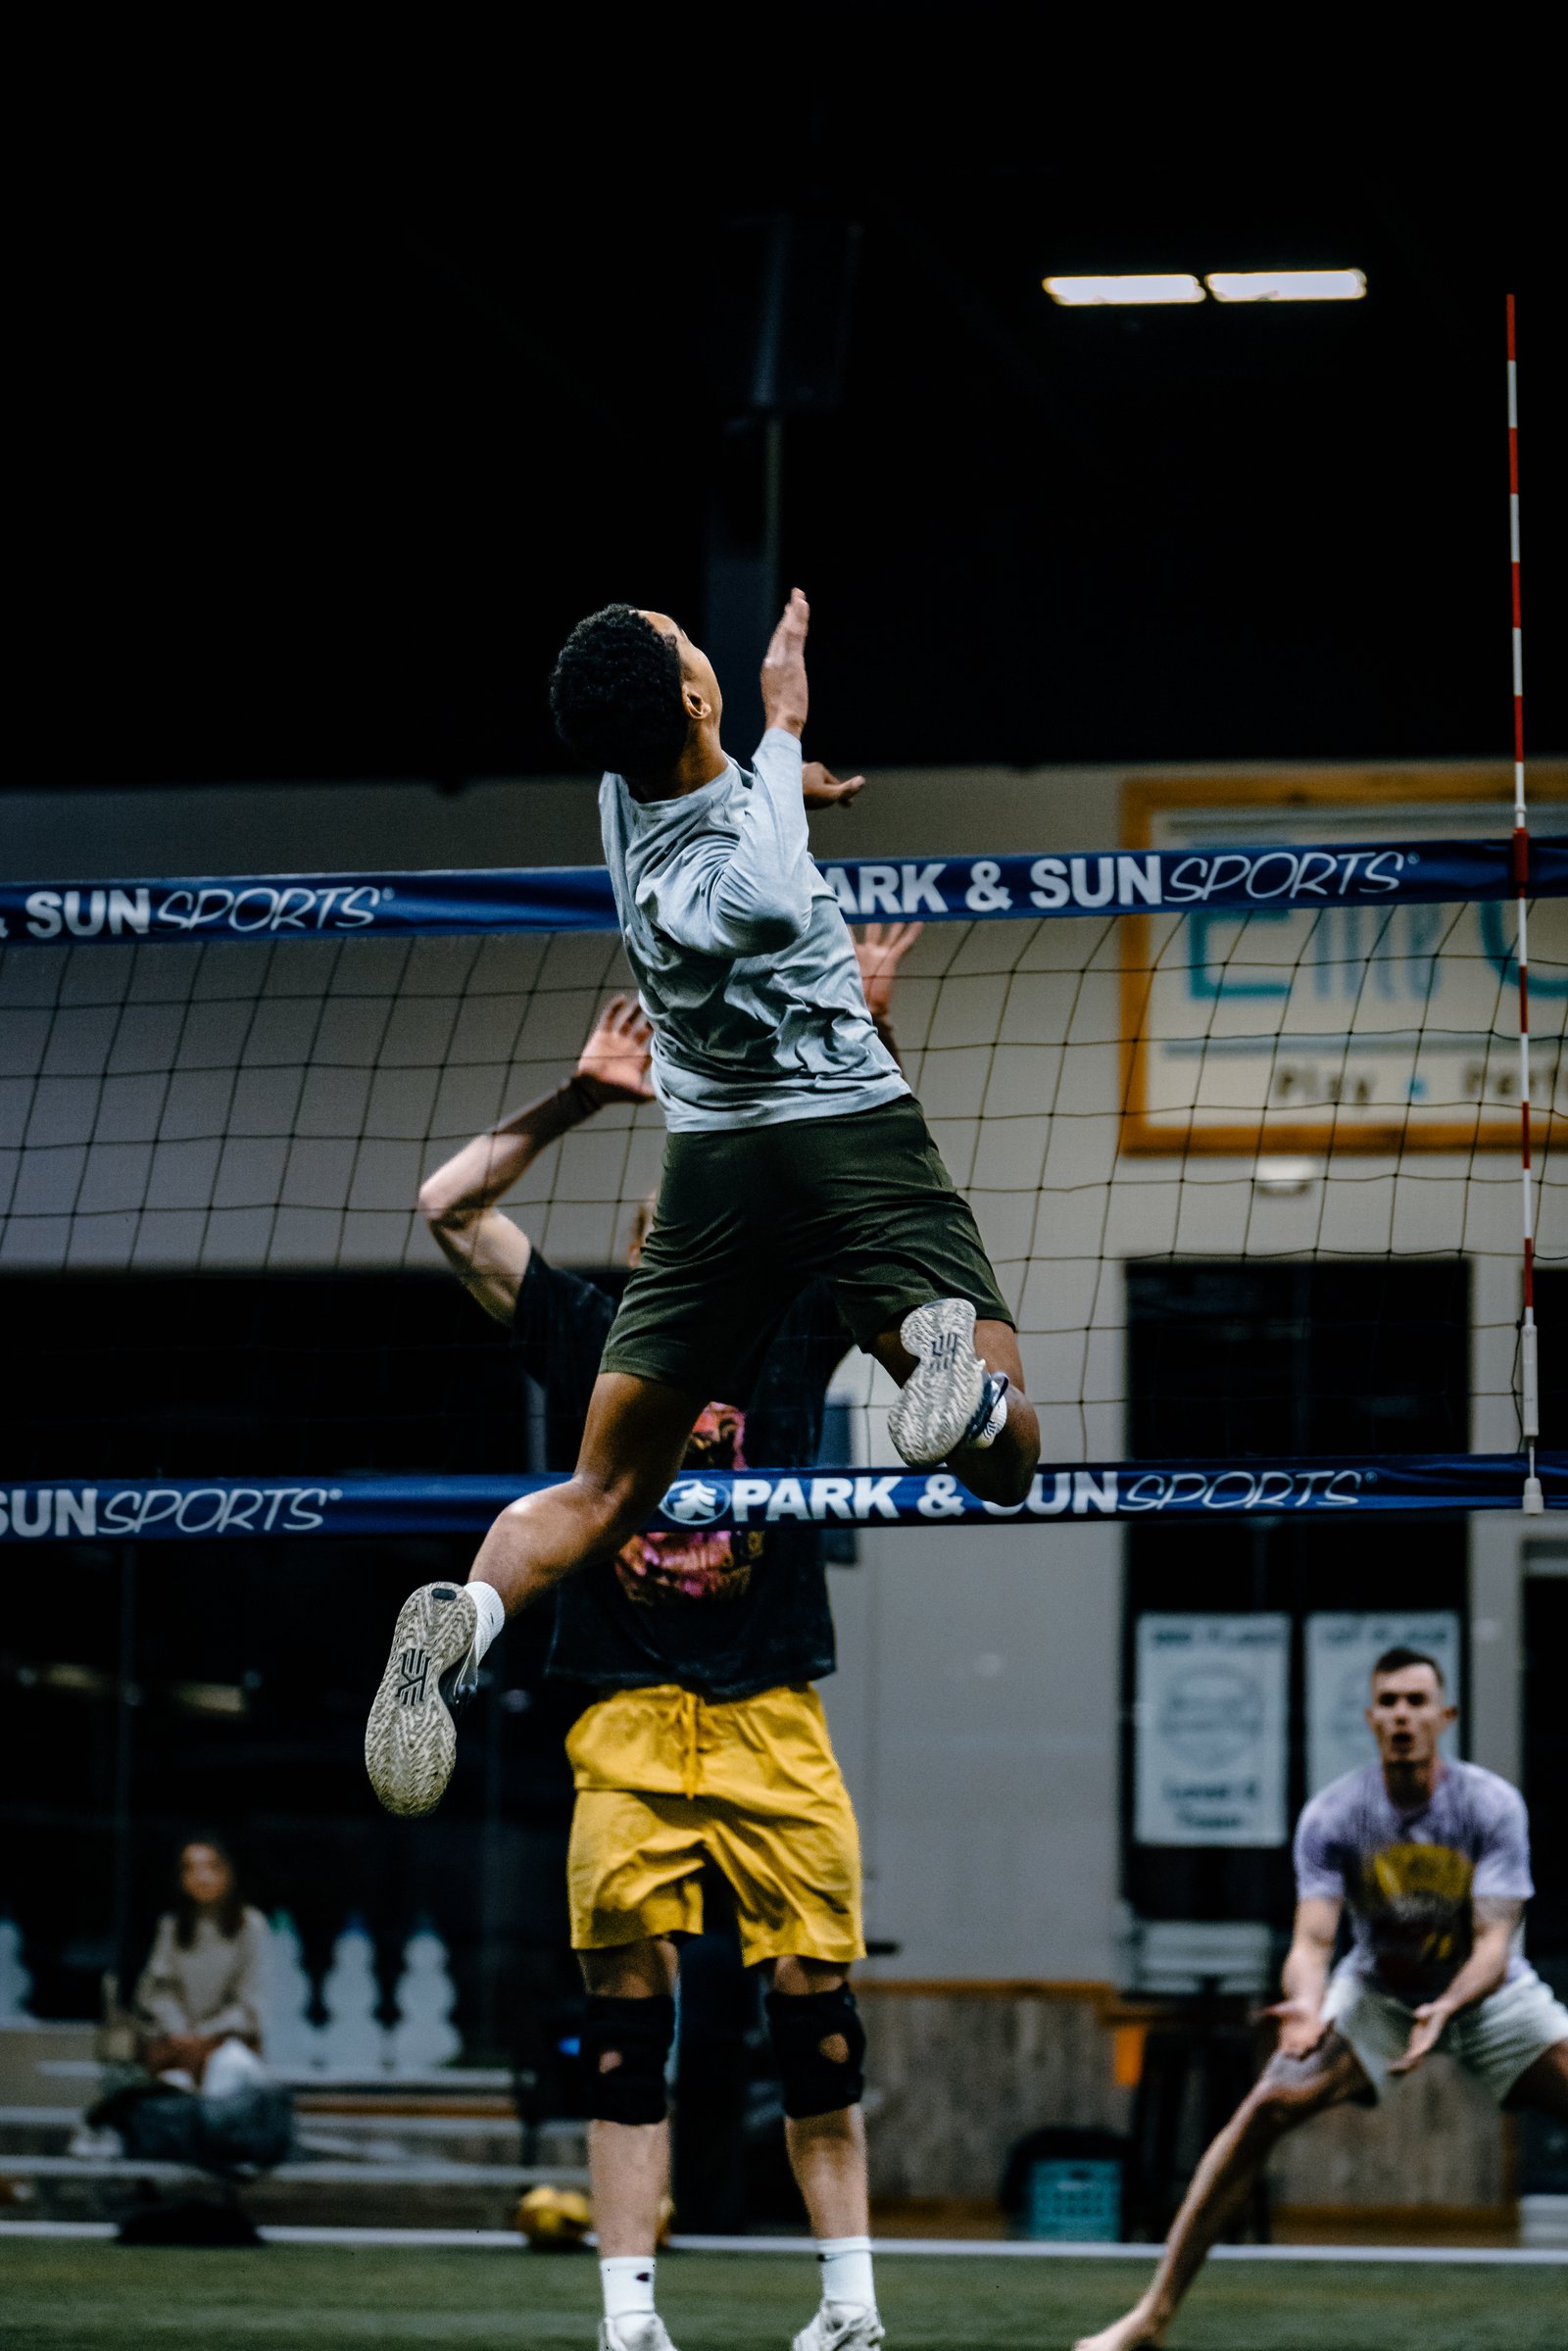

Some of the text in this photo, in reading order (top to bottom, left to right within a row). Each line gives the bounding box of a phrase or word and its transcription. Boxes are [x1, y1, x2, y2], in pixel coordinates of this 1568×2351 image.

[824, 863, 949, 914] ARK
[965, 860, 1012, 911] &
[1030, 856, 1162, 908] SUN
[25, 888, 150, 938] SUN
[0, 1488, 98, 1538] UN
[731, 1475, 903, 1522] PARK
[917, 1474, 966, 1518] &
[983, 1472, 1118, 1516] UN
